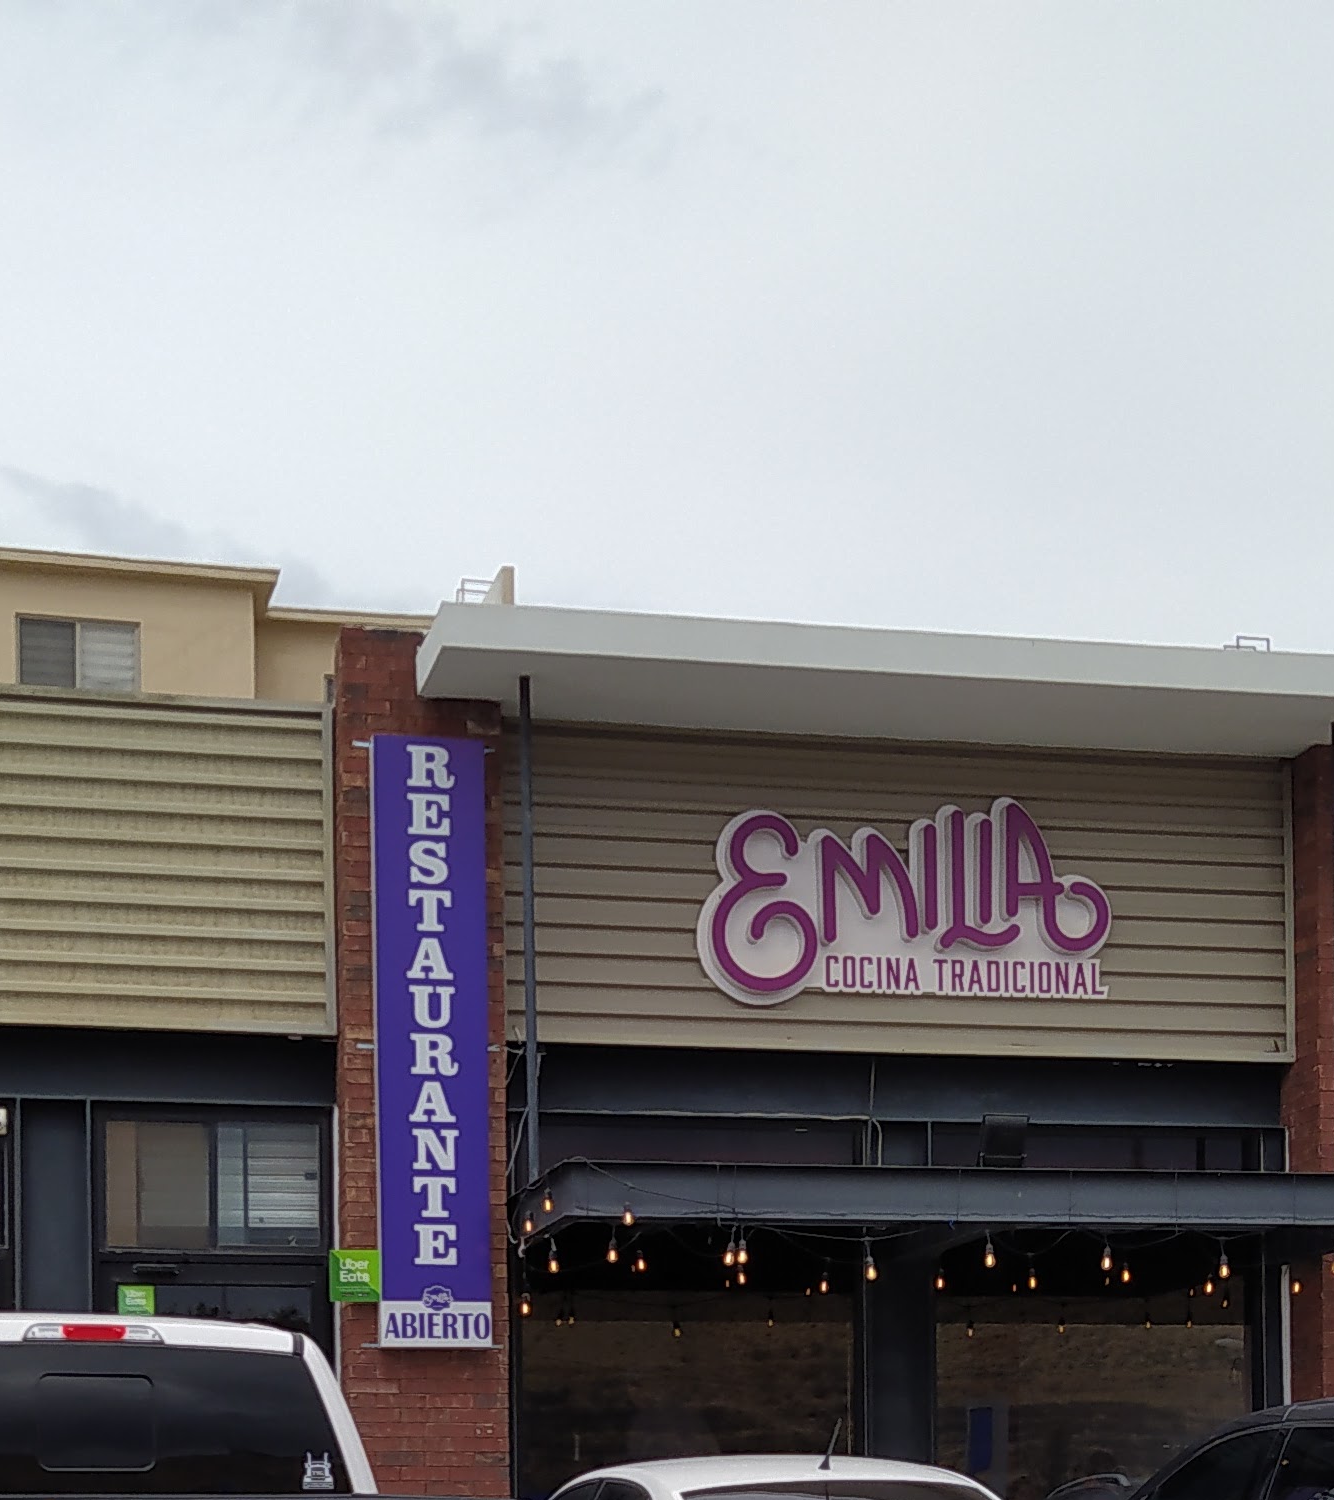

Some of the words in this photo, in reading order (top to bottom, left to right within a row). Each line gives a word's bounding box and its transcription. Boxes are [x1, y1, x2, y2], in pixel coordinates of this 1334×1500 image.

[825, 956, 920, 989] COCINA
[933, 959, 1106, 996] TRADICIONAL
[406, 745, 459, 1265] RESTAURANTE
[340, 1258, 369, 1270] Uber
[384, 1313, 490, 1340] ABIERTO
